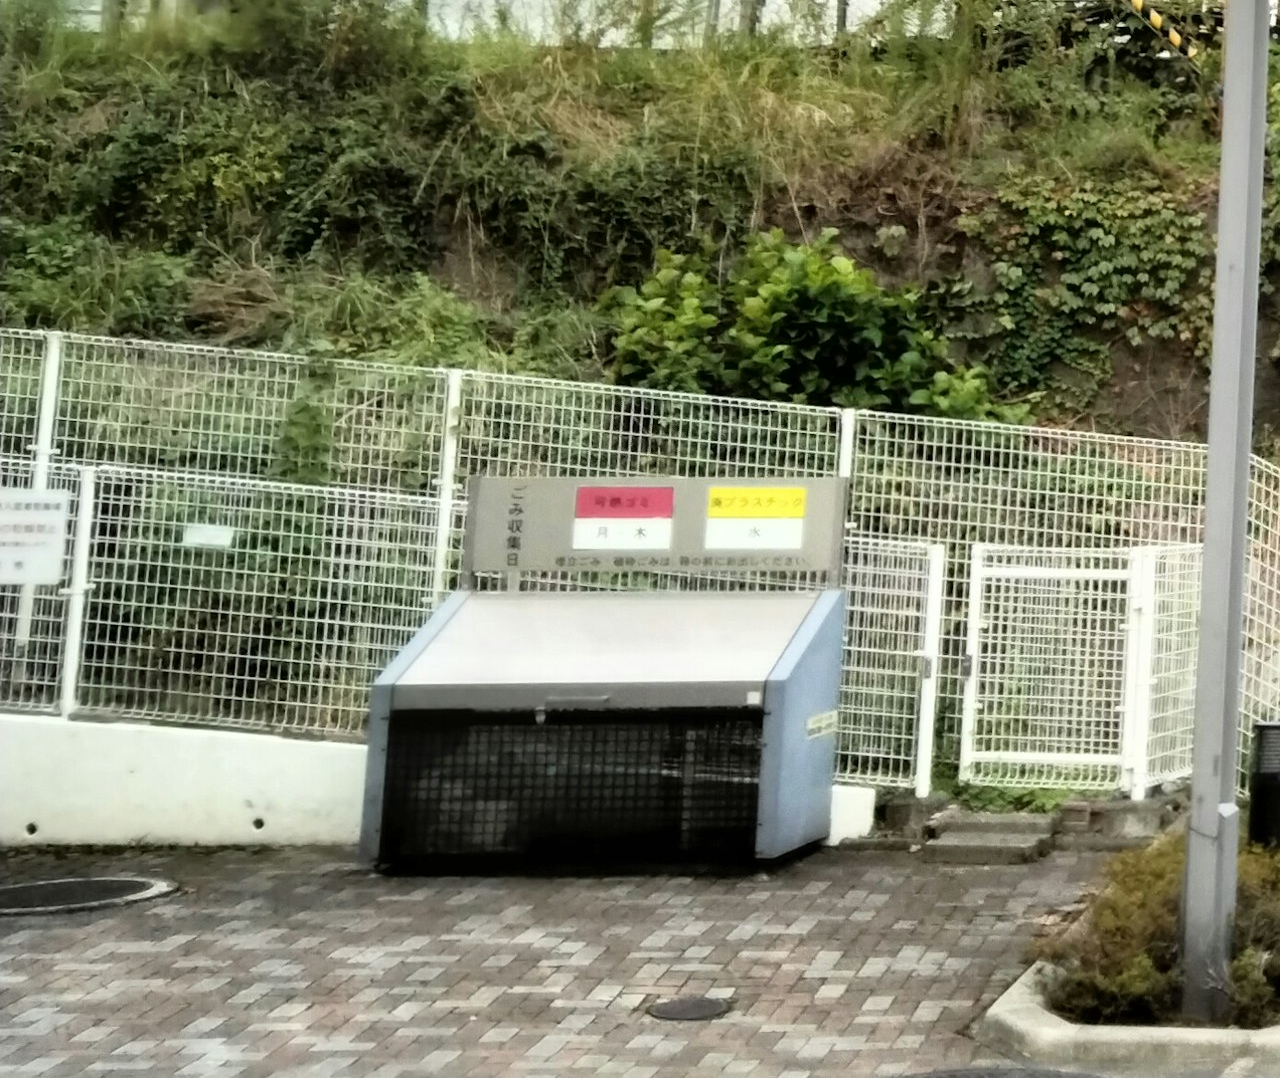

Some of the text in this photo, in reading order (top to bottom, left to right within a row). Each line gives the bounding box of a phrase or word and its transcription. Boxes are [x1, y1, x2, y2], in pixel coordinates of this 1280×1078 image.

[507, 485, 527, 566] ごみ収集日
[748, 526, 760, 538] 水
